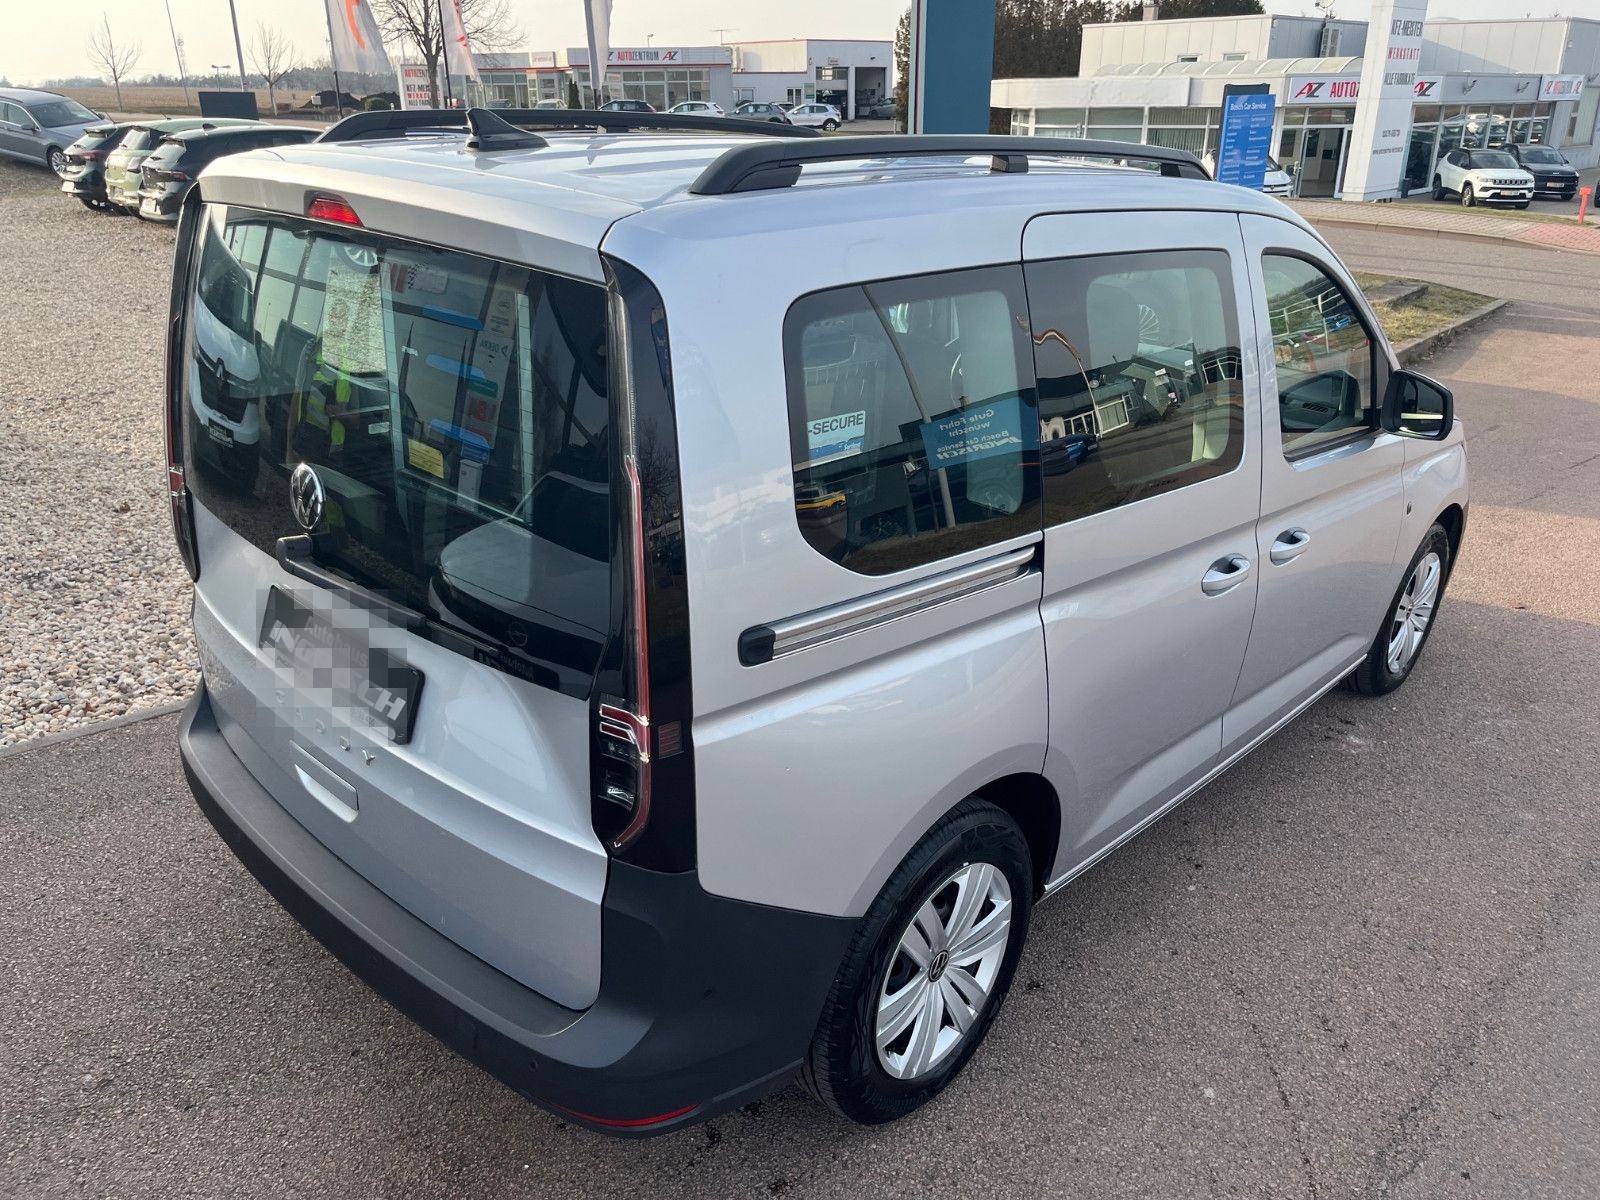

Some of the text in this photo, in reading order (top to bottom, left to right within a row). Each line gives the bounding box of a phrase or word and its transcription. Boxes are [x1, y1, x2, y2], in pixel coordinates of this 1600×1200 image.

[617, 50, 660, 62] AUTOZENTRUM
[662, 50, 679, 61] AZ
[1294, 82, 1326, 98] AZ
